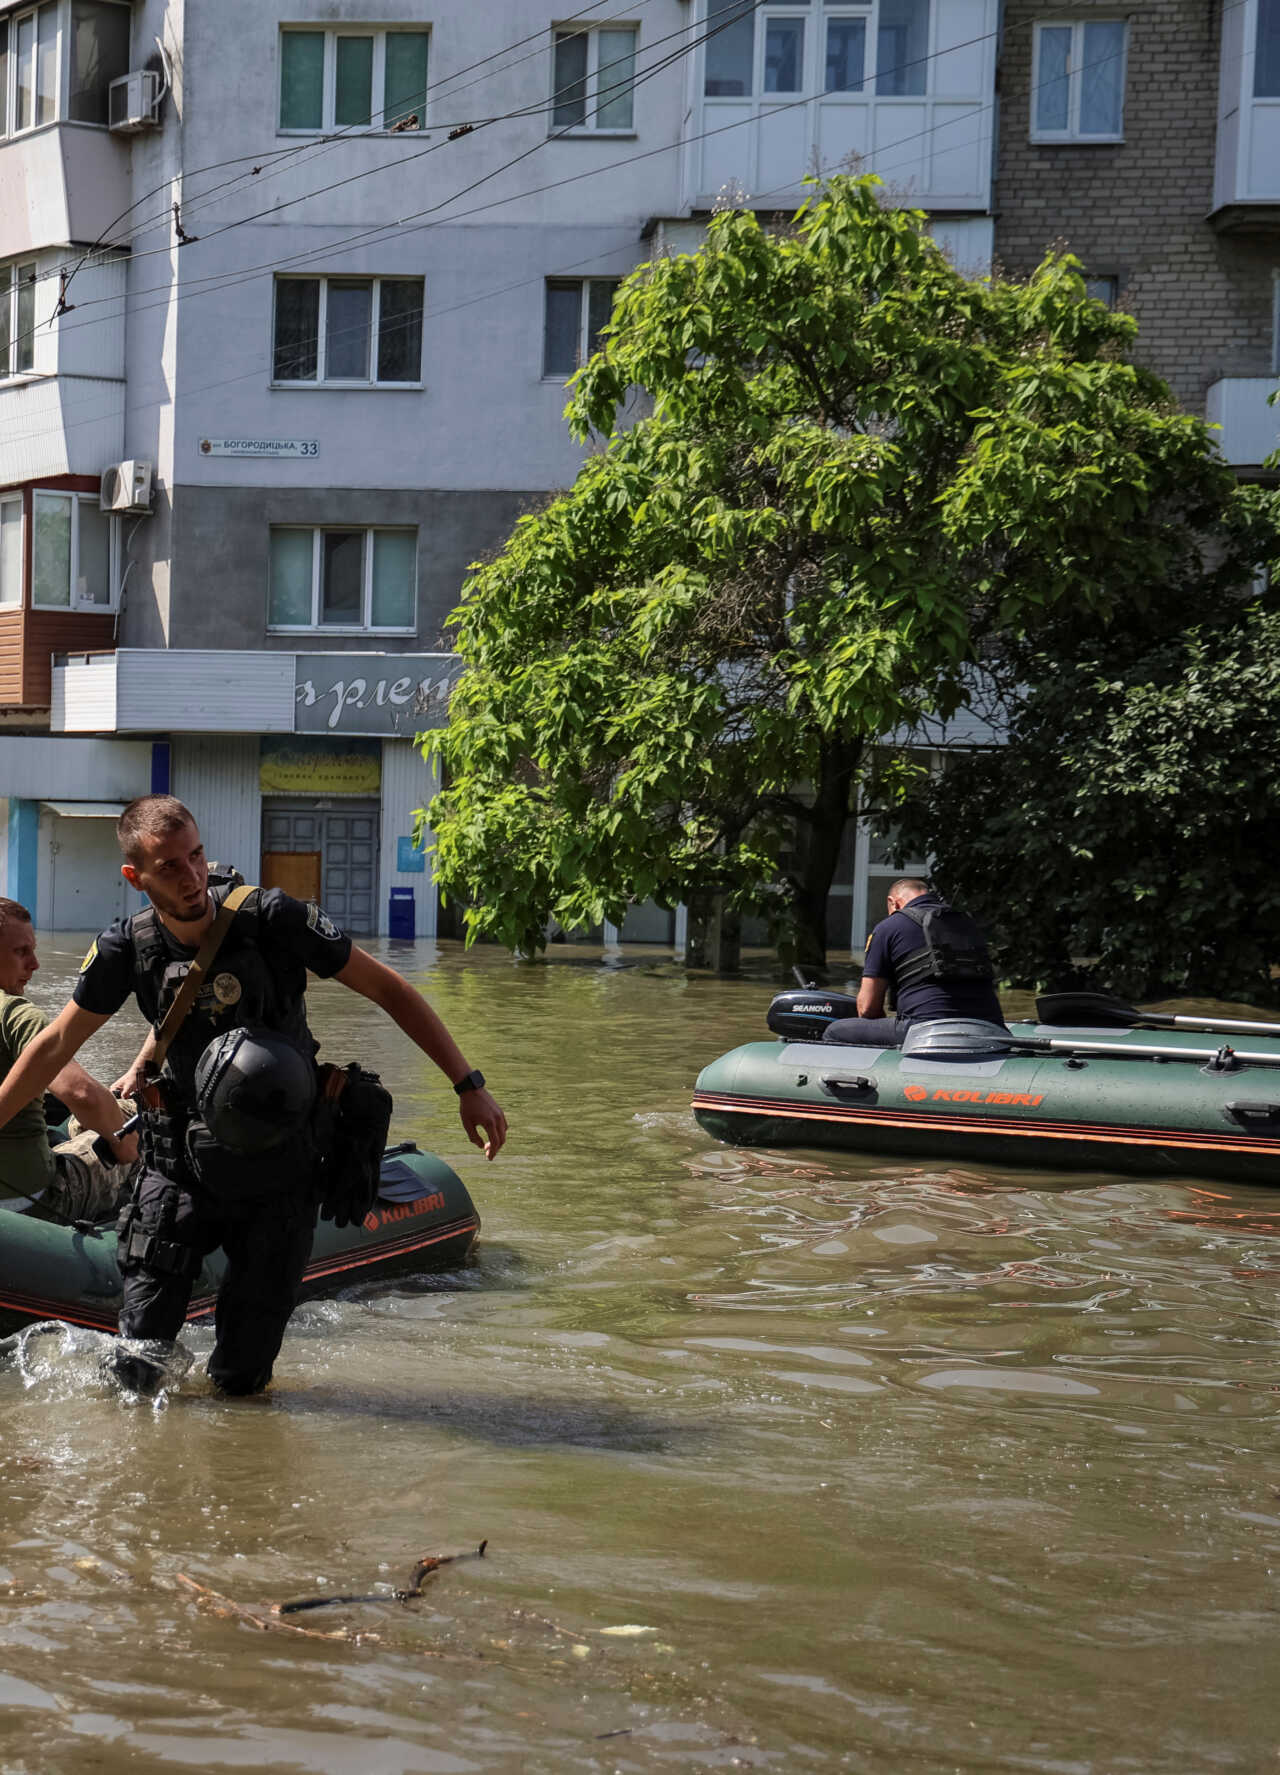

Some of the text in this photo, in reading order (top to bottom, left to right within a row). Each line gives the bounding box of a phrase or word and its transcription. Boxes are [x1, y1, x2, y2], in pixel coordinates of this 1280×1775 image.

[224, 441, 298, 450] БОГОРОДИЦЬКА,
[300, 442, 318, 455] 33
[792, 1005, 832, 1013] SEANOVO
[933, 1089, 1044, 1106] KOLIBRI
